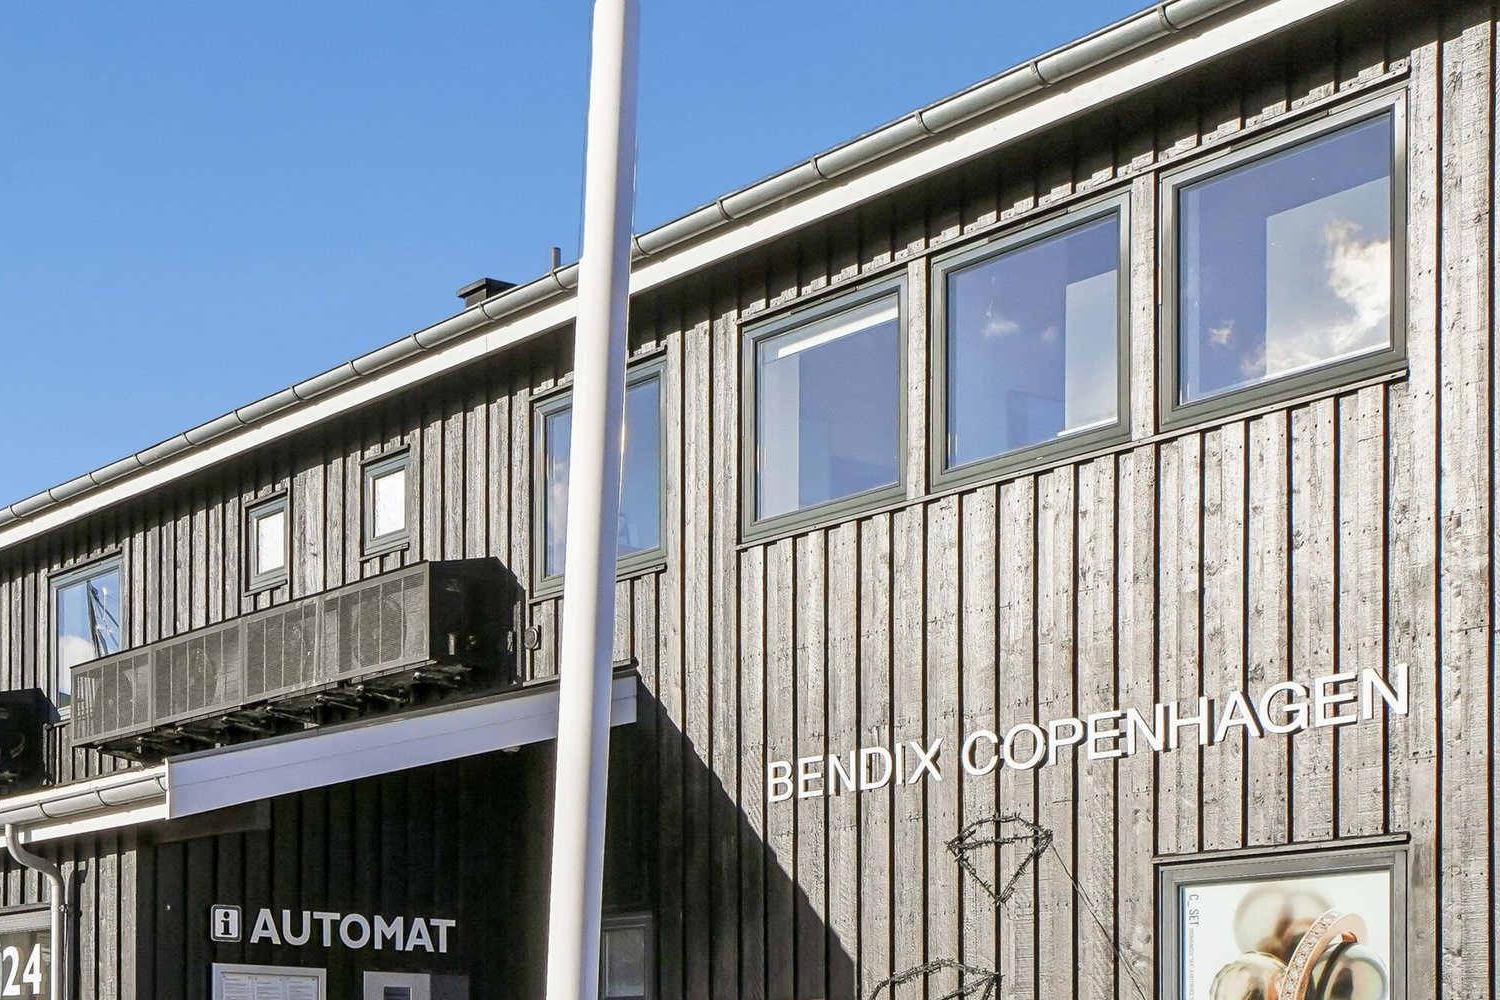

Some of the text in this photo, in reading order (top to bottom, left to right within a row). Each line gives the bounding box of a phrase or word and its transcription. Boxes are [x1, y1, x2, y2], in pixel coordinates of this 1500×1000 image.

[765, 662, 1410, 804] BENDIX COPENHAGEN
[249, 907, 457, 954] AUTOMAT
[1188, 909, 1199, 926] SET
[1, 942, 43, 998] 24
